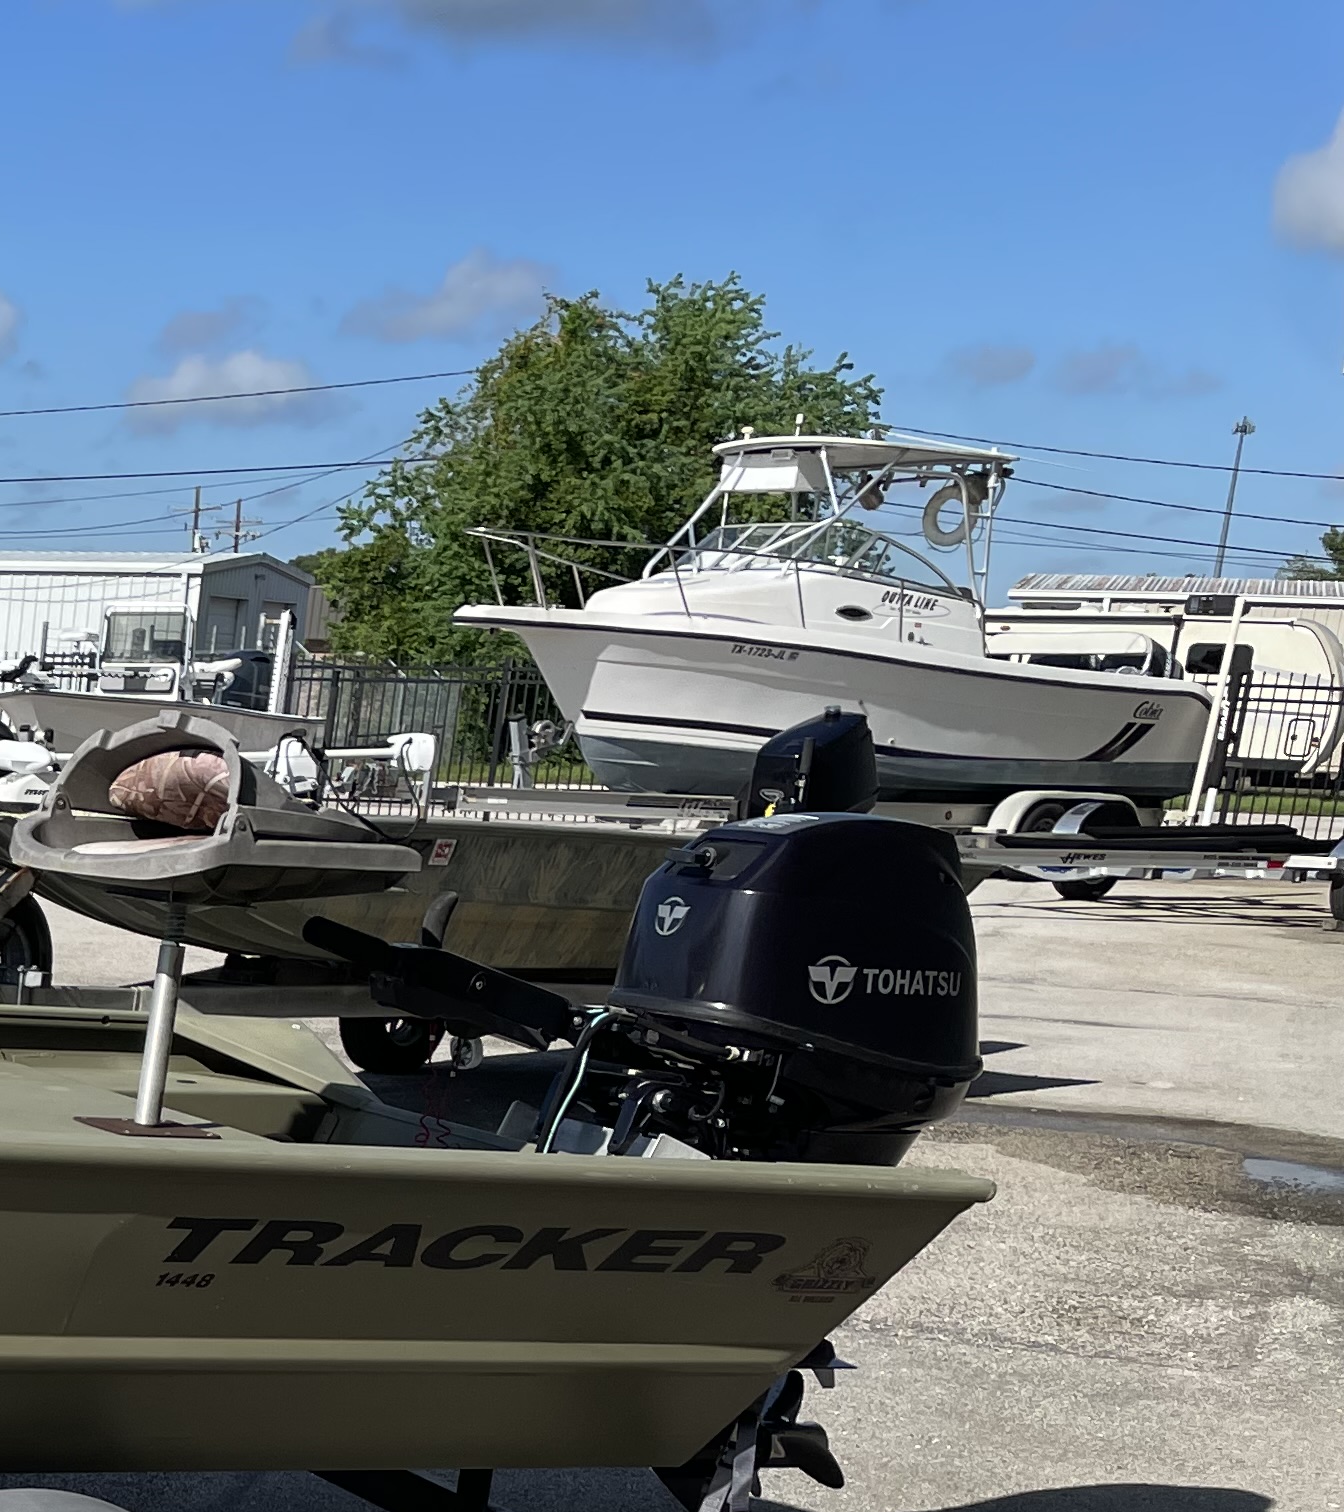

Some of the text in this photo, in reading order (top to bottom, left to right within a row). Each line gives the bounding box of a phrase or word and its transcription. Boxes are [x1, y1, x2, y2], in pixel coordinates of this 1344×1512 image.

[863, 968, 961, 997] TOHATSU
[162, 1216, 787, 1274] TRACKER
[155, 1272, 216, 1289] 1448
